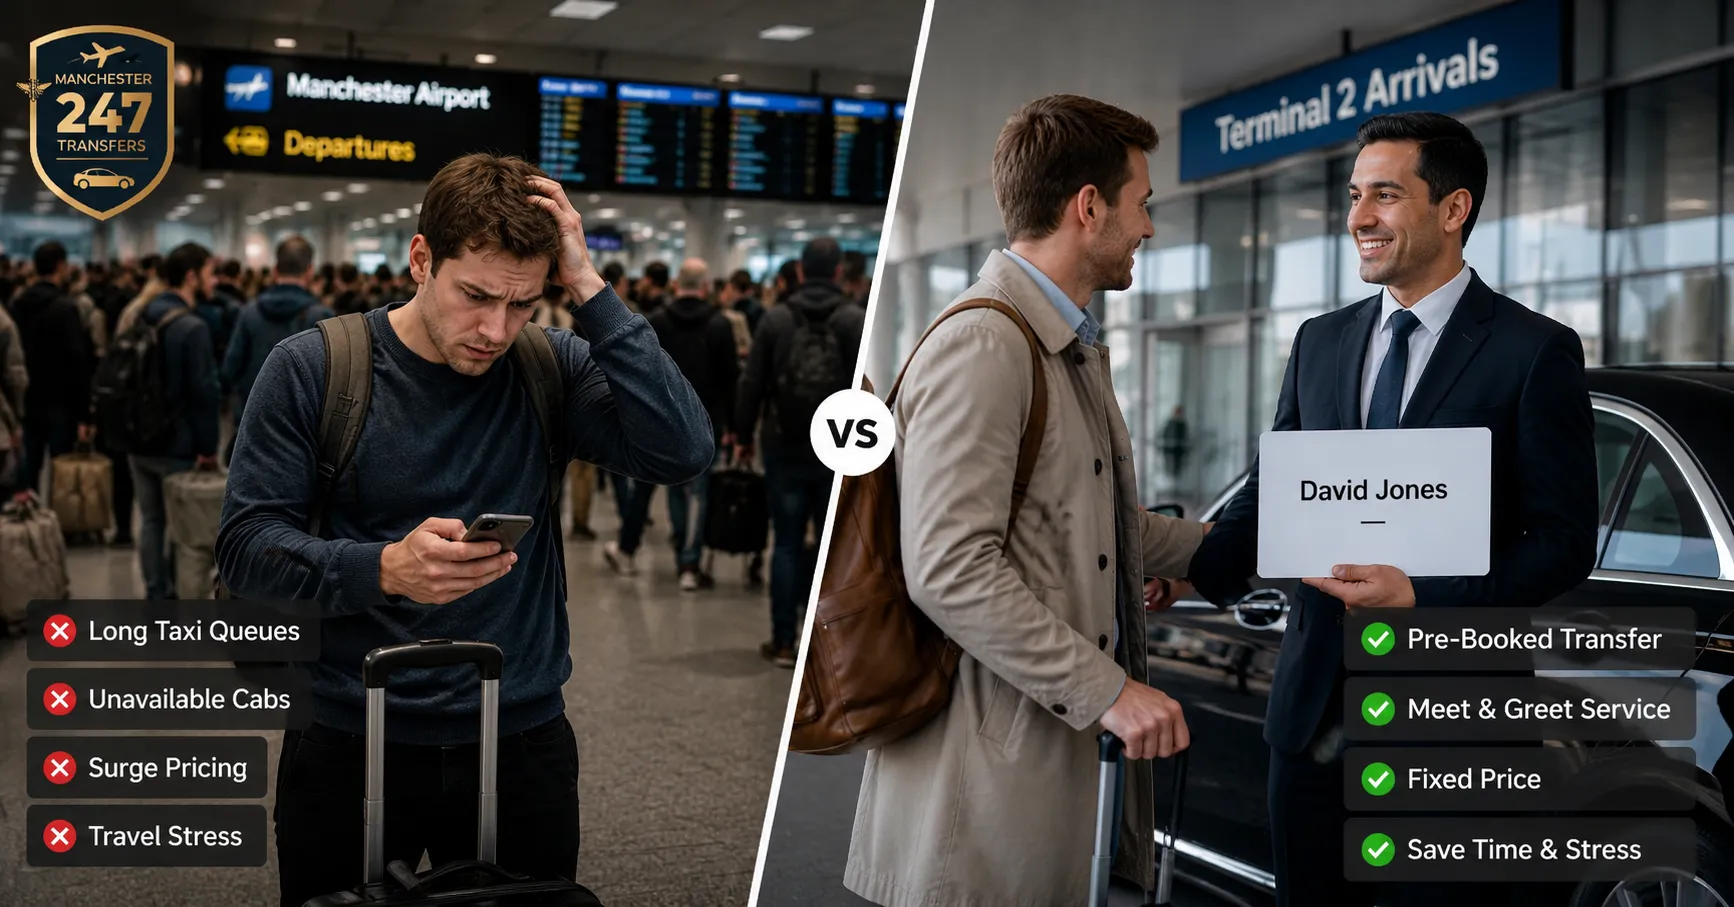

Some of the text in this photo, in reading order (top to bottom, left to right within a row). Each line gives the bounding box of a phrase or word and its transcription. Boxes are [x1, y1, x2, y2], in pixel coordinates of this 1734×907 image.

[286, 72, 491, 112] Manchester Airport
[1215, 37, 1499, 154] Terminal 2 Arrivals
[284, 129, 416, 162] Departures
[1300, 478, 1448, 501] David Jones
